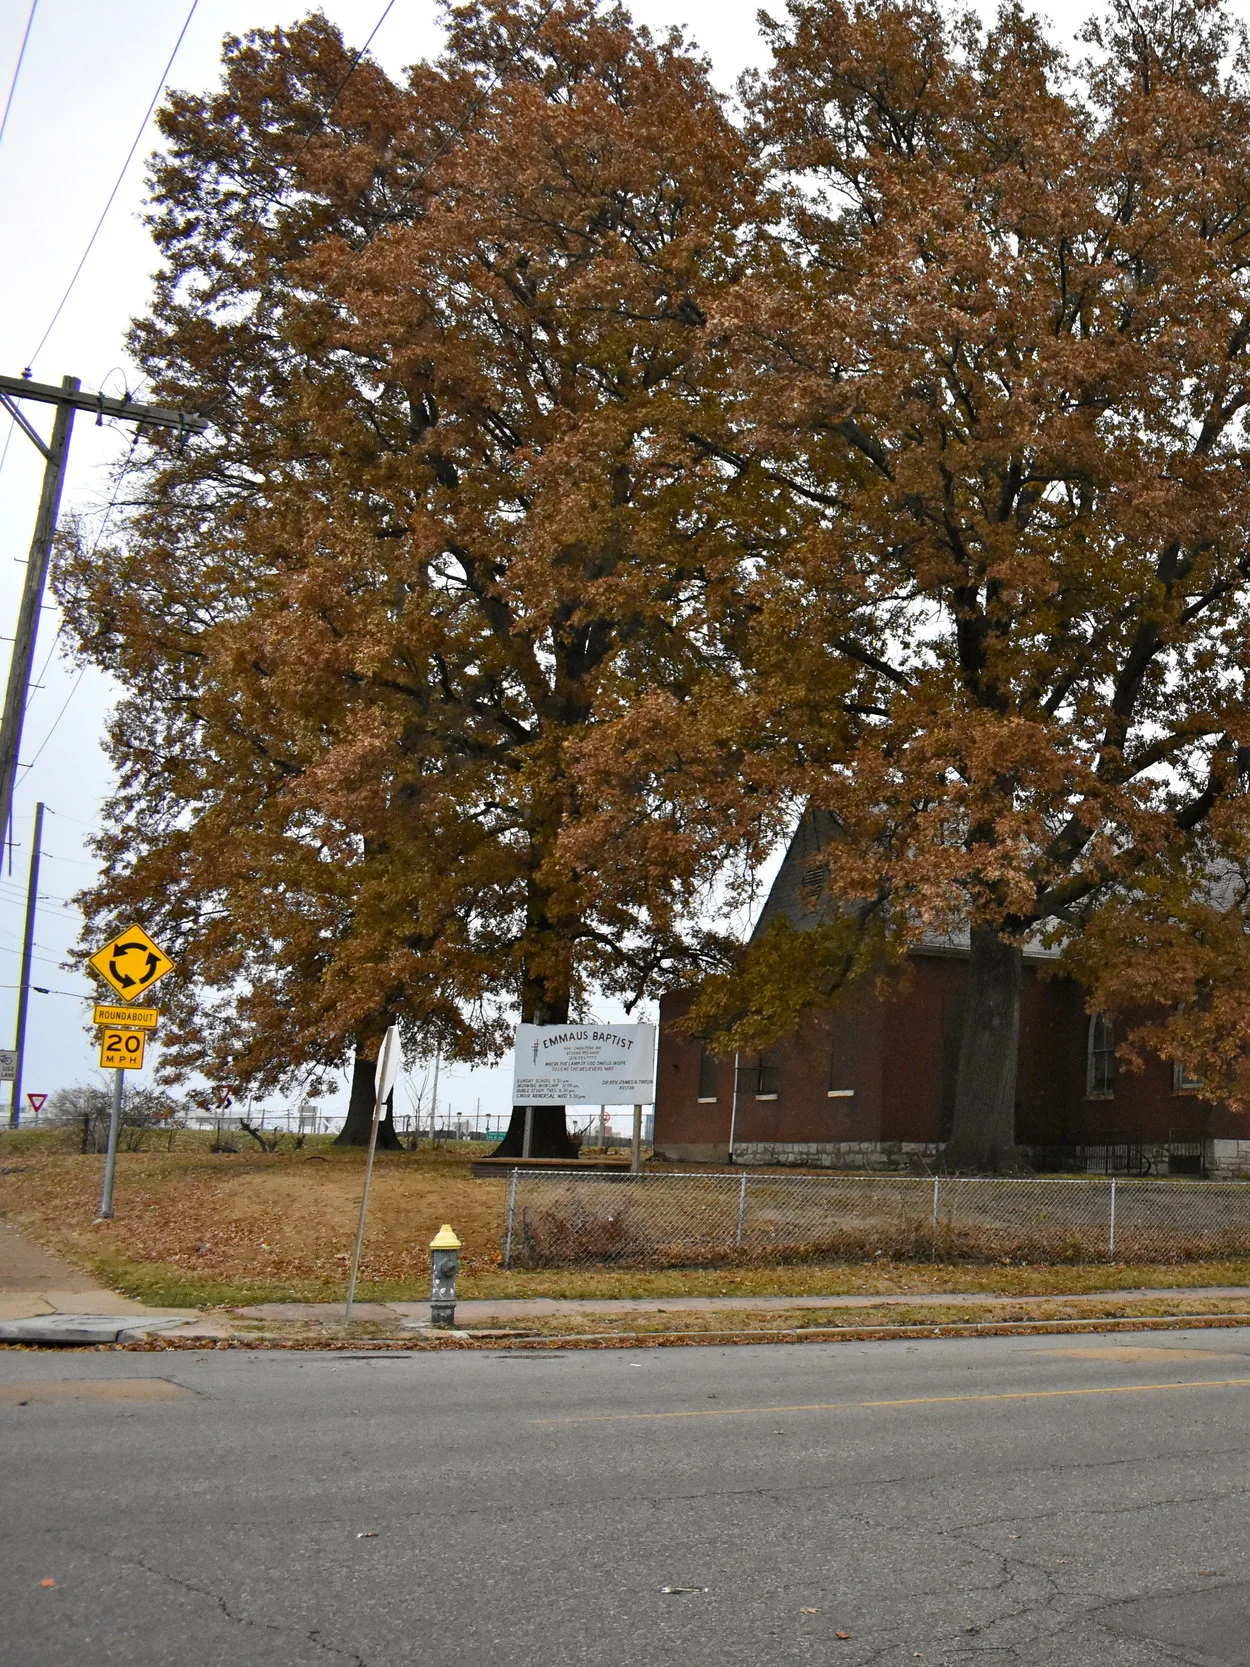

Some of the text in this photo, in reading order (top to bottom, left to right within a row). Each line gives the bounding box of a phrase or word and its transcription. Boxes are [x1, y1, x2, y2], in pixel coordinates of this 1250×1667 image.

[98, 1010, 154, 1022] ROUNDABOUT
[106, 1034, 141, 1053] 20
[543, 1030, 634, 1050] EMMAUS BAPTIST
[105, 1055, 137, 1064] MPH
